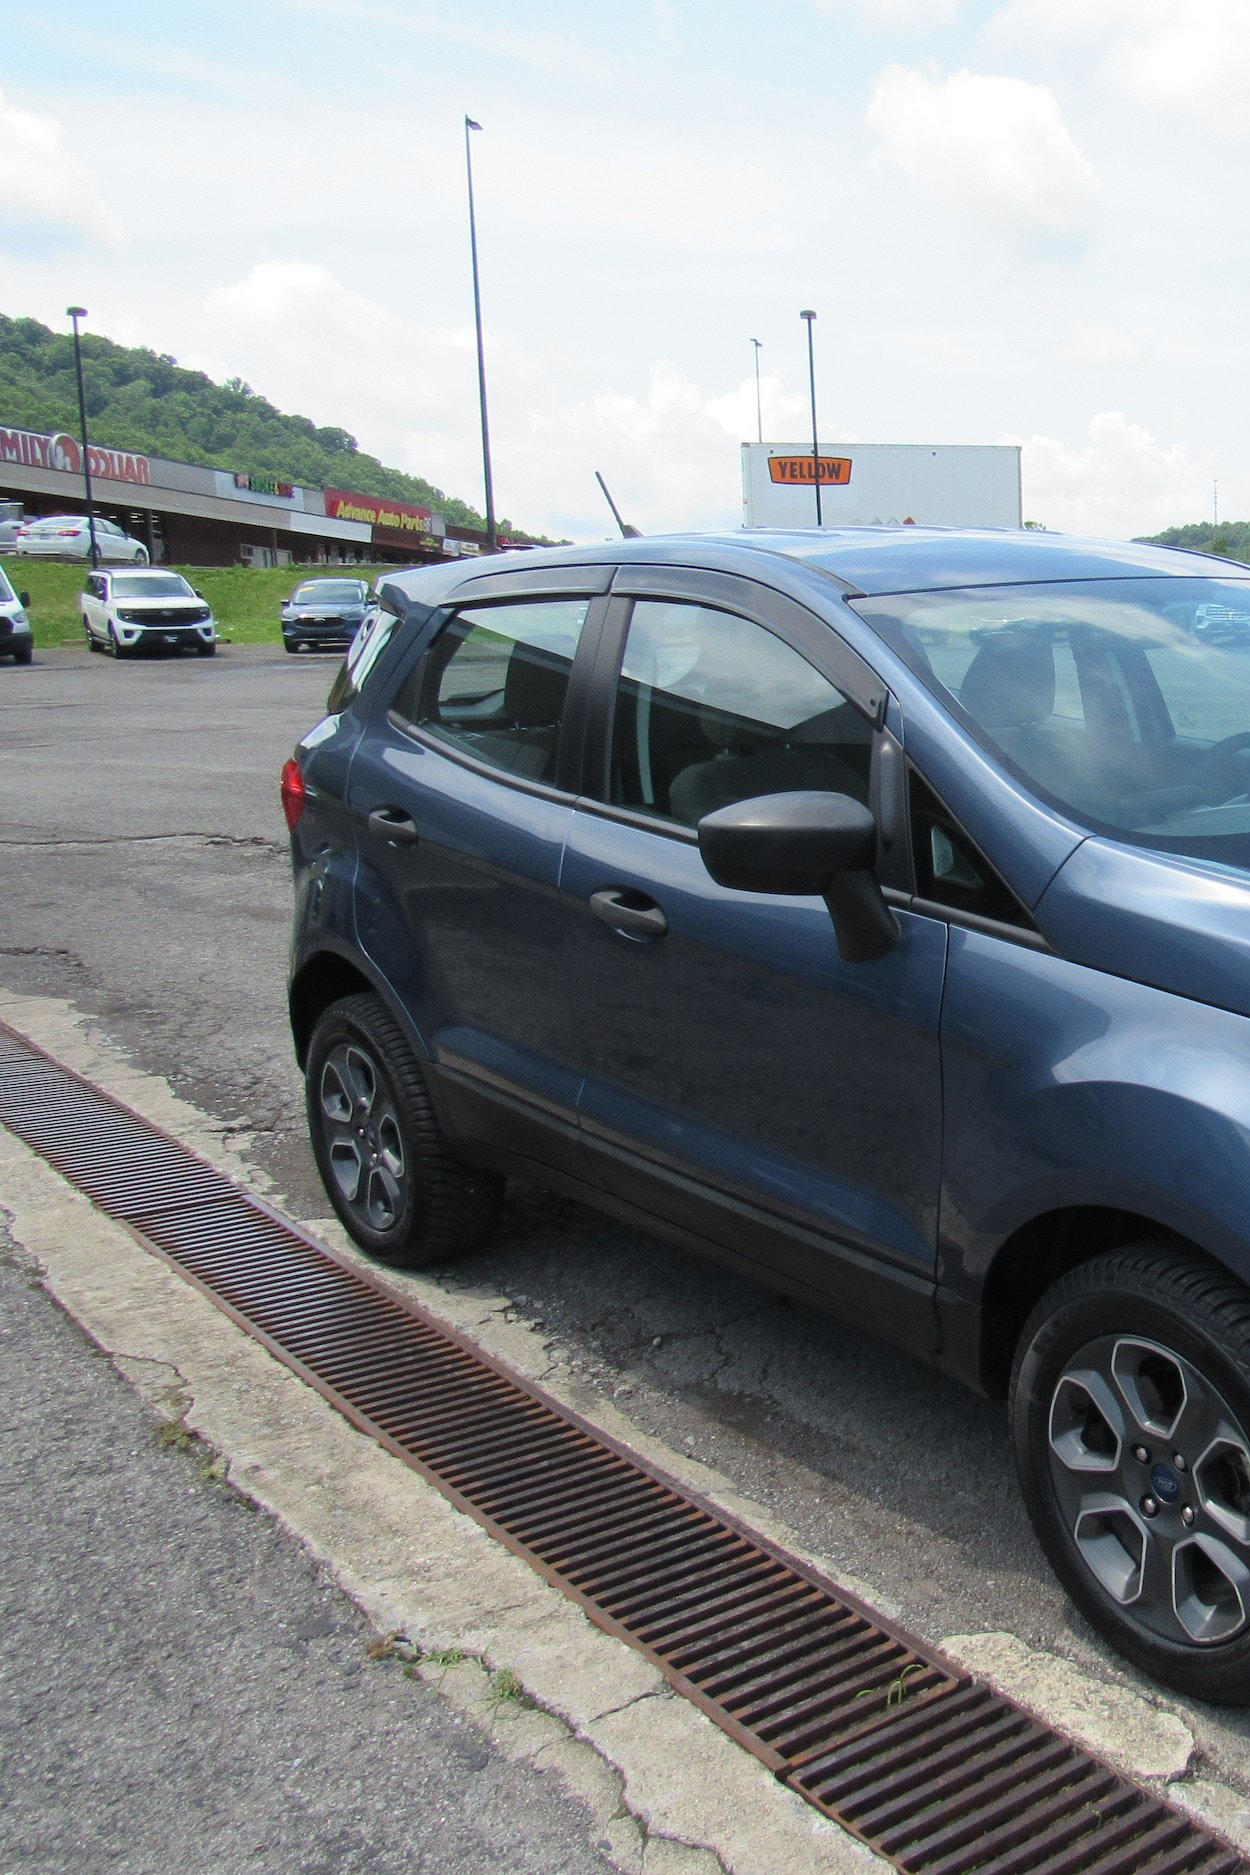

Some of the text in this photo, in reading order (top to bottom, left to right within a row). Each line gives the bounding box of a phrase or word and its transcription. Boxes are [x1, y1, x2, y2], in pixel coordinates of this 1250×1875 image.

[81, 444, 151, 485] DOLLAR
[778, 461, 841, 479] YELLOW
[336, 500, 425, 532] Advance Auto Parts
